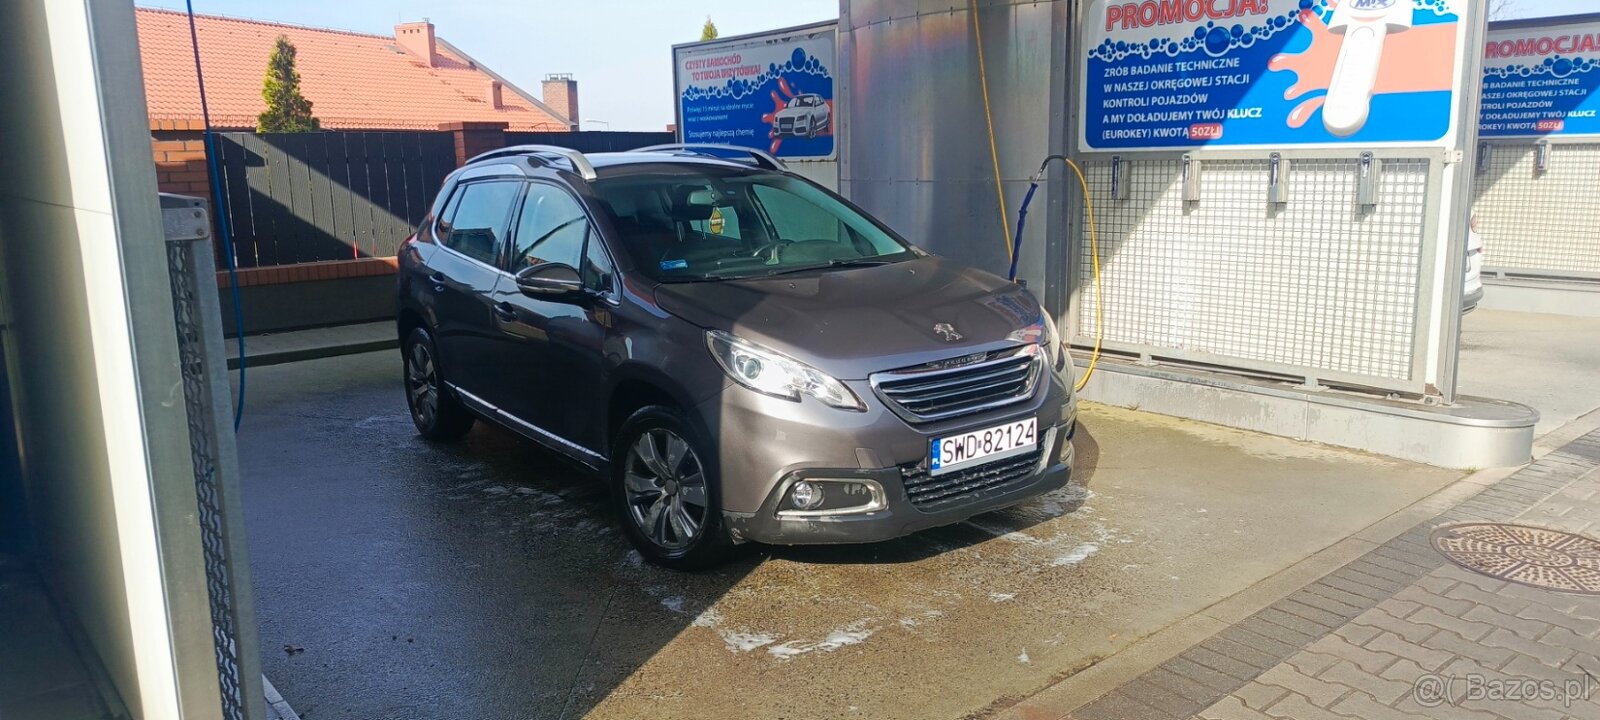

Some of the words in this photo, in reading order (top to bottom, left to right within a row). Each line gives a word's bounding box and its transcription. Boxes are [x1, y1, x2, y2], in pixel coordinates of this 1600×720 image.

[1106, 0, 1268, 31] PROMOCJA!
[685, 59, 706, 70] CZYSTY
[707, 53, 742, 68] SAMOCHÓD
[1104, 66, 1129, 78] ZRÓB
[1131, 63, 1173, 76] BADANIE
[1175, 58, 1240, 72] TECHNICZNE
[692, 72, 700, 81] TO
[700, 70, 720, 80] TWOJA
[1104, 84, 1113, 93] W
[1114, 80, 1148, 92] NASZEJ
[1150, 76, 1212, 91] OKRĘGOWEJ
[1215, 74, 1250, 86] STACJI
[1490, 81, 1526, 89] BADANIE
[1528, 78, 1580, 88] TECHNICZNE
[1103, 97, 1150, 108] KONTROLI
[1152, 92, 1208, 106] POJAZDÓW
[1506, 90, 1558, 99] OKRĘGOWEJ
[1559, 88, 1587, 96] STACJI
[1481, 102, 1504, 110] TROLI
[1506, 100, 1553, 109] POJAZDÓW
[1102, 114, 1110, 124] A
[1111, 113, 1125, 123] MY
[1127, 110, 1194, 122] DOŁADUJEMY
[1196, 108, 1225, 120] TWÓJ
[1227, 107, 1262, 119] KLUCZ
[1486, 111, 1540, 120] DOŁADUJEMY
[1542, 110, 1566, 118] TWÓJ
[1567, 110, 1596, 118] KLUCZ
[1506, 122, 1536, 130] KWOTĄ
[688, 130, 712, 139] Stosujemy
[712, 129, 735, 138] najlepszą
[736, 128, 754, 137] chemię
[1102, 128, 1151, 140] (EUROKEY)
[1153, 127, 1190, 140] KWOTĄ
[943, 435, 977, 464] SWD
[983, 420, 1034, 454] 82124
